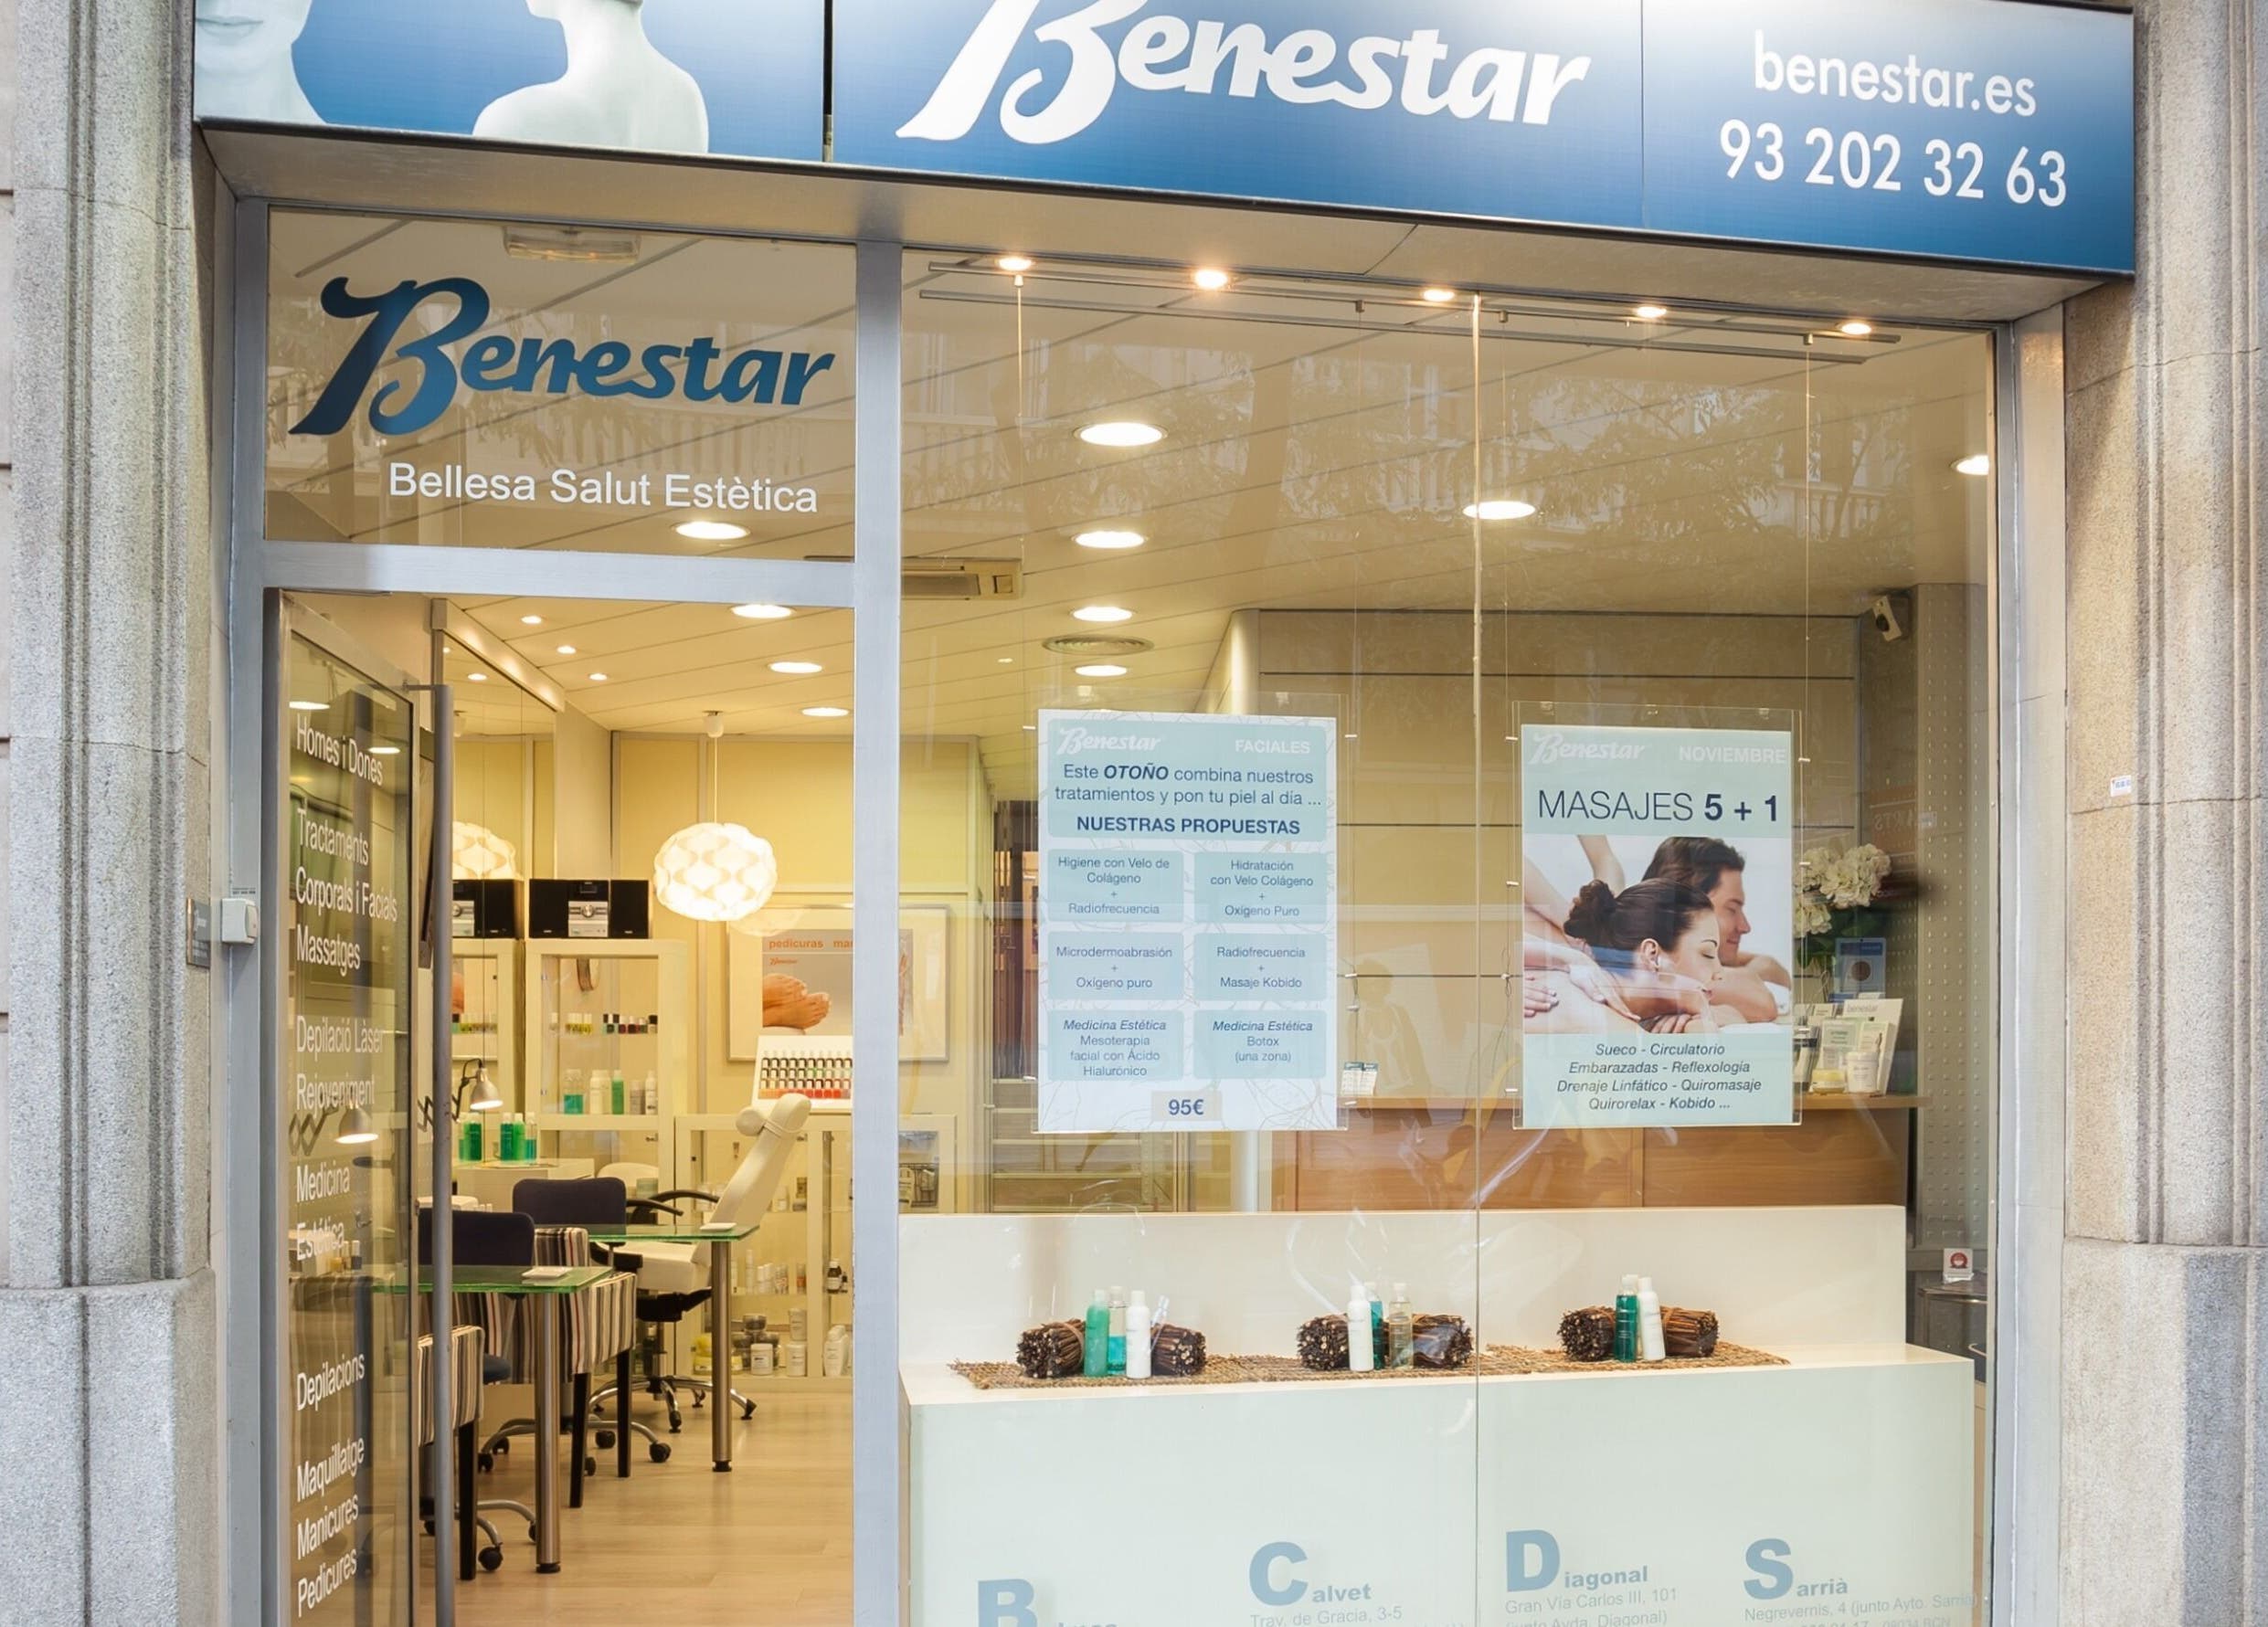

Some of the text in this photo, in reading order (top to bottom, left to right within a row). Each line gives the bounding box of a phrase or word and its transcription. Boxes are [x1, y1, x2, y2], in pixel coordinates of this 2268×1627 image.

[896, 0, 1591, 144] Benestar
[1754, 29, 2038, 117] benestar.es
[1720, 119, 2067, 207] 93 202 32 63
[289, 276, 836, 436] Benestar
[388, 462, 818, 512] Bellesa Salut Estètica
[297, 714, 383, 787] Homes i Dones
[1056, 727, 1310, 755] Benestar FACIALES
[1528, 733, 1786, 766] Benestar NOVIEMBRE
[1064, 762, 1313, 784] Este OTOÑO combina nuestros
[1055, 786, 1154, 801] tratamientos
[1160, 789, 1169, 805] y
[1174, 790, 1203, 806] pon
[1209, 789, 1224, 804] tu
[1229, 788, 1256, 807] piel
[1262, 789, 1274, 805] al
[1539, 789, 1777, 822] MASAJES 5 + 1
[1076, 816, 1300, 835] NUESTRAS PROPUESTAS
[297, 808, 369, 866] Tractaments
[1058, 857, 1170, 870] Higiene con Velo de
[1231, 860, 1294, 872] Hidratación
[1086, 872, 1141, 886] Colágeno
[1210, 874, 1314, 889] con Velo Colágeno
[296, 866, 397, 922] Corporals i Facials
[1068, 902, 1160, 915] Radiofrecuencia
[1274, 904, 1299, 916] Puro
[296, 924, 361, 977] Massatges
[768, 938, 823, 949] pedicuras
[1056, 946, 1172, 958] Microdermoabrasión
[1217, 946, 1306, 958] Radiofrecuencia
[1127, 978, 1153, 991] puro
[1220, 977, 1302, 991] Masaje Kobido
[1063, 1019, 1118, 1031] Medicina
[1213, 1020, 1265, 1032] Medicina
[297, 1015, 352, 1062] Depilació
[1080, 1034, 1150, 1050] Mesoterapia
[1246, 1035, 1279, 1047] Botox
[1595, 1042, 1637, 1056] Sueco
[1649, 1042, 1725, 1056] Circulatorio
[1070, 1050, 1101, 1062] facial
[1103, 1052, 1125, 1062] con
[1235, 1051, 1292, 1063] (una zona)
[1083, 1064, 1148, 1077] Hialurónico
[1569, 1061, 1659, 1074] Embarazadas
[1671, 1061, 1751, 1077] Reflexología
[297, 1072, 376, 1119] Rejoveniment
[1556, 1079, 1608, 1095] Drenaje
[1611, 1078, 1669, 1093] Linfático
[1680, 1078, 1762, 1094] Quiromasaje
[1168, 1099, 1205, 1116] 95€
[1588, 1096, 1657, 1111] Quirorelax
[1669, 1095, 1716, 1110] Kobido
[297, 1158, 351, 1203] Medicina
[297, 1352, 366, 1411] Depilacions
[297, 1437, 365, 1503] Maquillatge
[298, 1494, 359, 1560] Manicures
[1506, 1529, 1648, 1591] Diagonal
[1743, 1537, 1849, 1601] Sarrià
[298, 1548, 357, 1618] Pedicures
[1249, 1541, 1372, 1607] Calvet
[1505, 1599, 1542, 1616] Gran
[1575, 1592, 1624, 1610] Carlos
[1628, 1590, 1646, 1606] III,
[1652, 1588, 1677, 1602] 101
[1744, 1603, 1833, 1623] Negrevernis,
[1838, 1602, 1847, 1617] 4
[1851, 1600, 1890, 1616] (junto
[1293, 1612, 1311, 1626] de
[1376, 1606, 1403, 1621] 3-5
